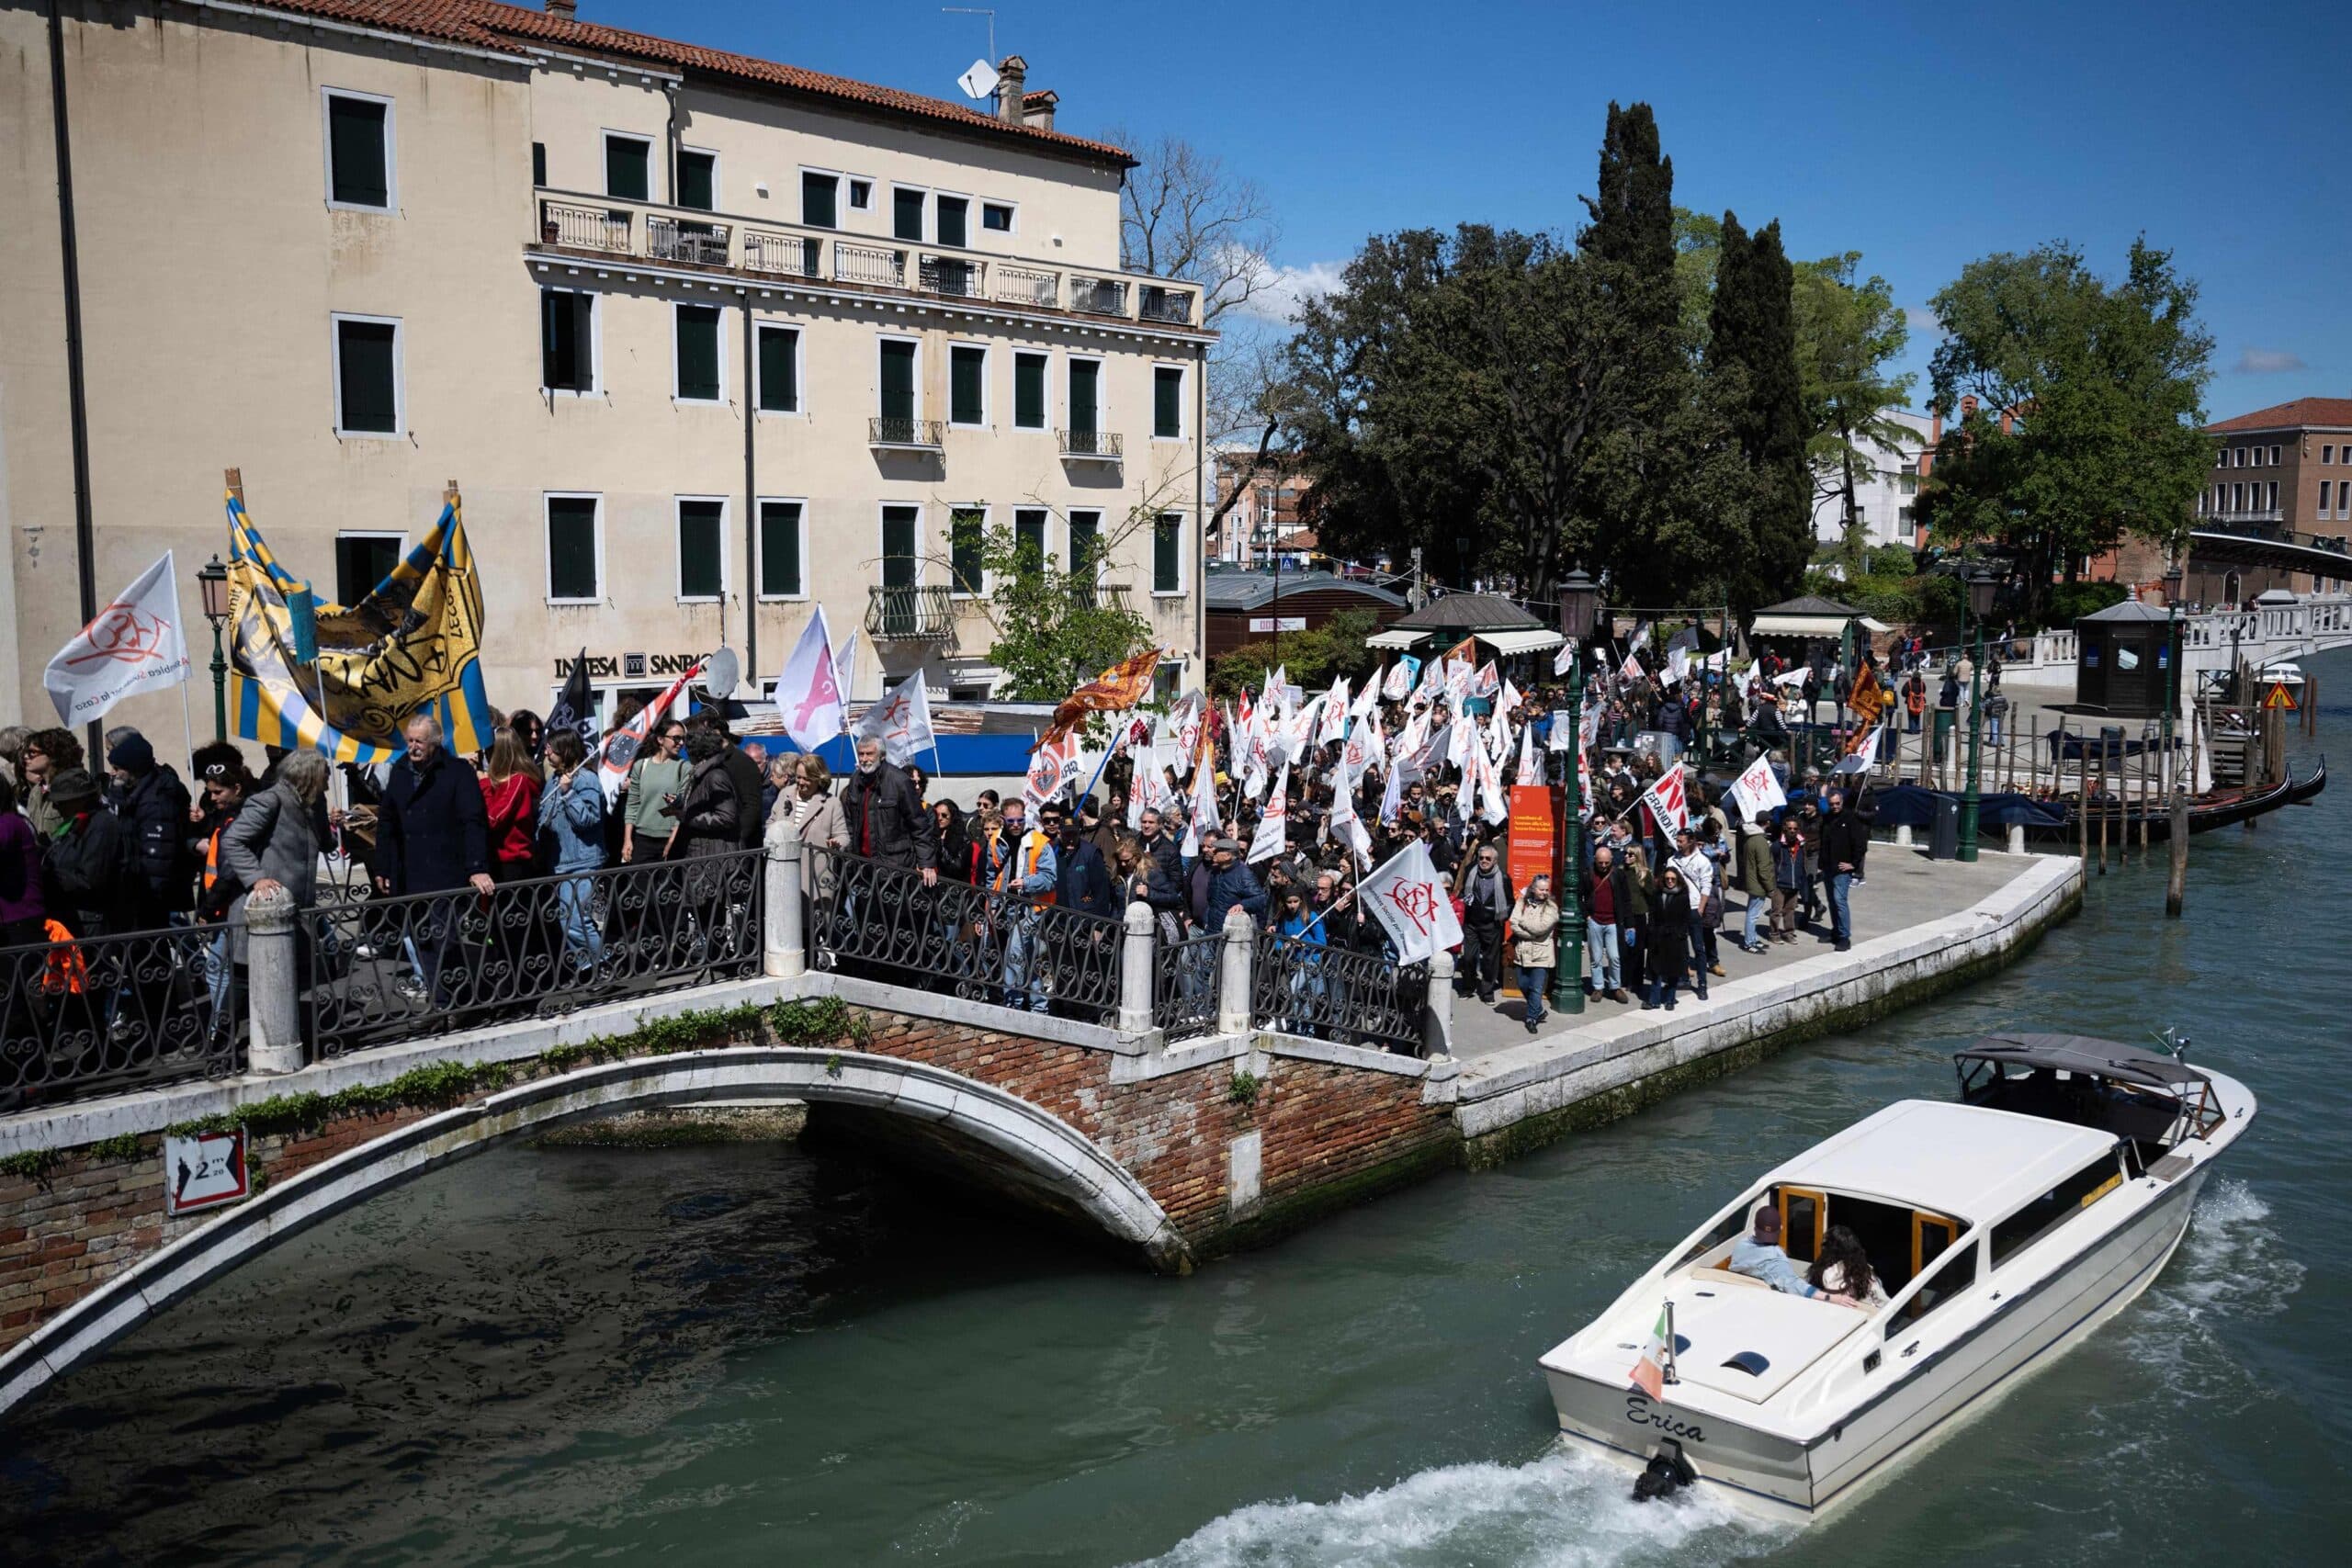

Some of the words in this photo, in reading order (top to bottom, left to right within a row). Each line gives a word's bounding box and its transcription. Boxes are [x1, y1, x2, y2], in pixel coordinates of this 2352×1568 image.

[554, 656, 619, 678] INESA
[1645, 792, 1672, 829] GRANDI
[195, 1161, 209, 1180] 2
[1625, 1395, 1707, 1443] Erica
